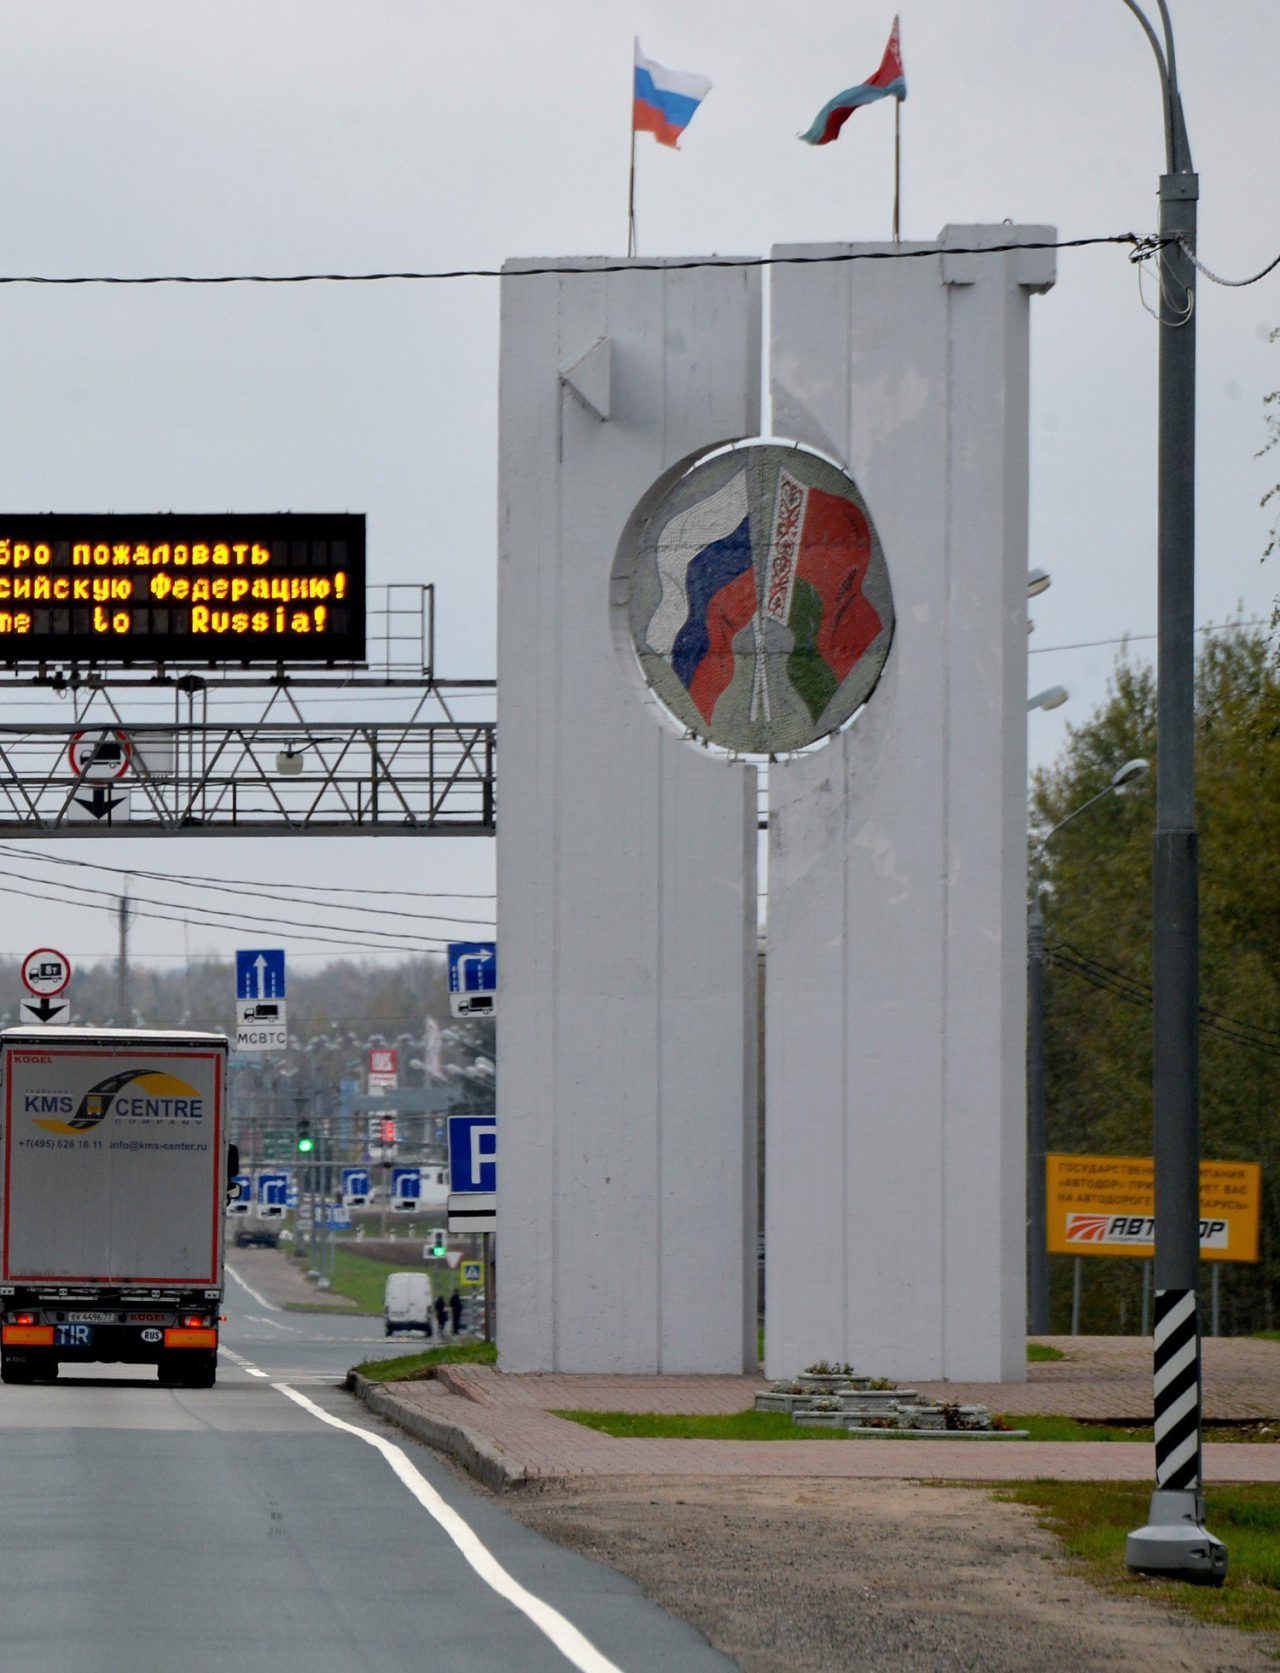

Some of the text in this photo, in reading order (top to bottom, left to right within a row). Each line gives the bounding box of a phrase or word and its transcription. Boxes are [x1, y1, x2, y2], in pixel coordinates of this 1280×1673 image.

[72, 543, 271, 567] пожаловать
[150, 571, 347, 602] Федерацию!
[93, 605, 131, 634] to
[191, 604, 327, 634] Russia!
[25, 1097, 202, 1117] KMS CENTRE
[19, 1139, 55, 1150] +7(495)
[92, 1140, 103, 1149] 11
[109, 1140, 208, 1152] info@kms-center.ru
[469, 1125, 496, 1184] P
[57, 1325, 89, 1345] TIR
[144, 1331, 160, 1340] RUS
